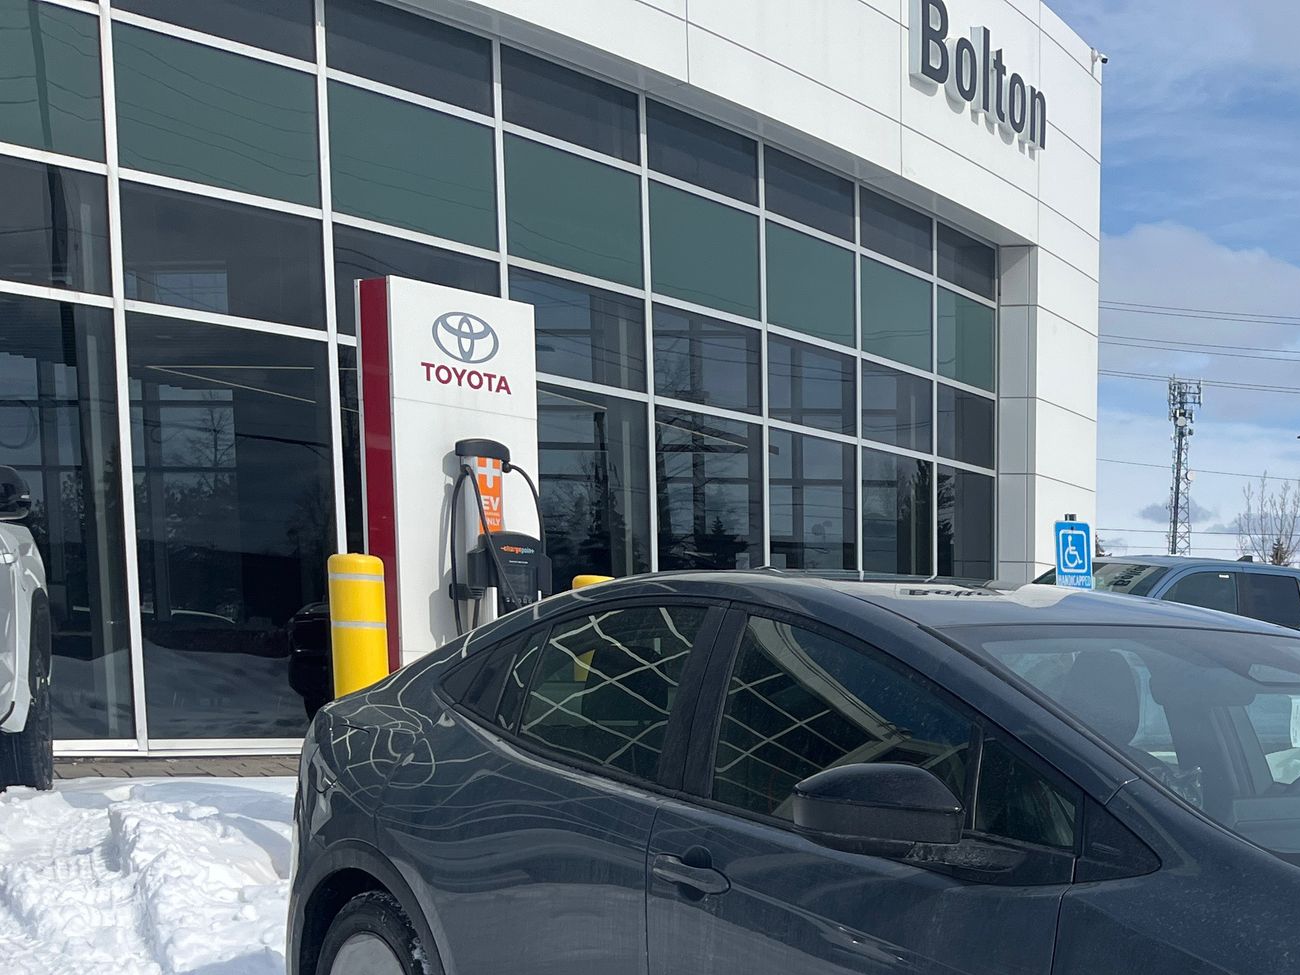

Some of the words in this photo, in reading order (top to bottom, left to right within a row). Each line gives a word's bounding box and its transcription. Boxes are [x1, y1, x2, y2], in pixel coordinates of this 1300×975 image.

[921, 0, 1046, 150] Bolton
[421, 361, 512, 395] TOYOTA
[481, 495, 500, 511] EV
[486, 518, 501, 526] NLY
[1058, 575, 1091, 587] HANDICAPPED
